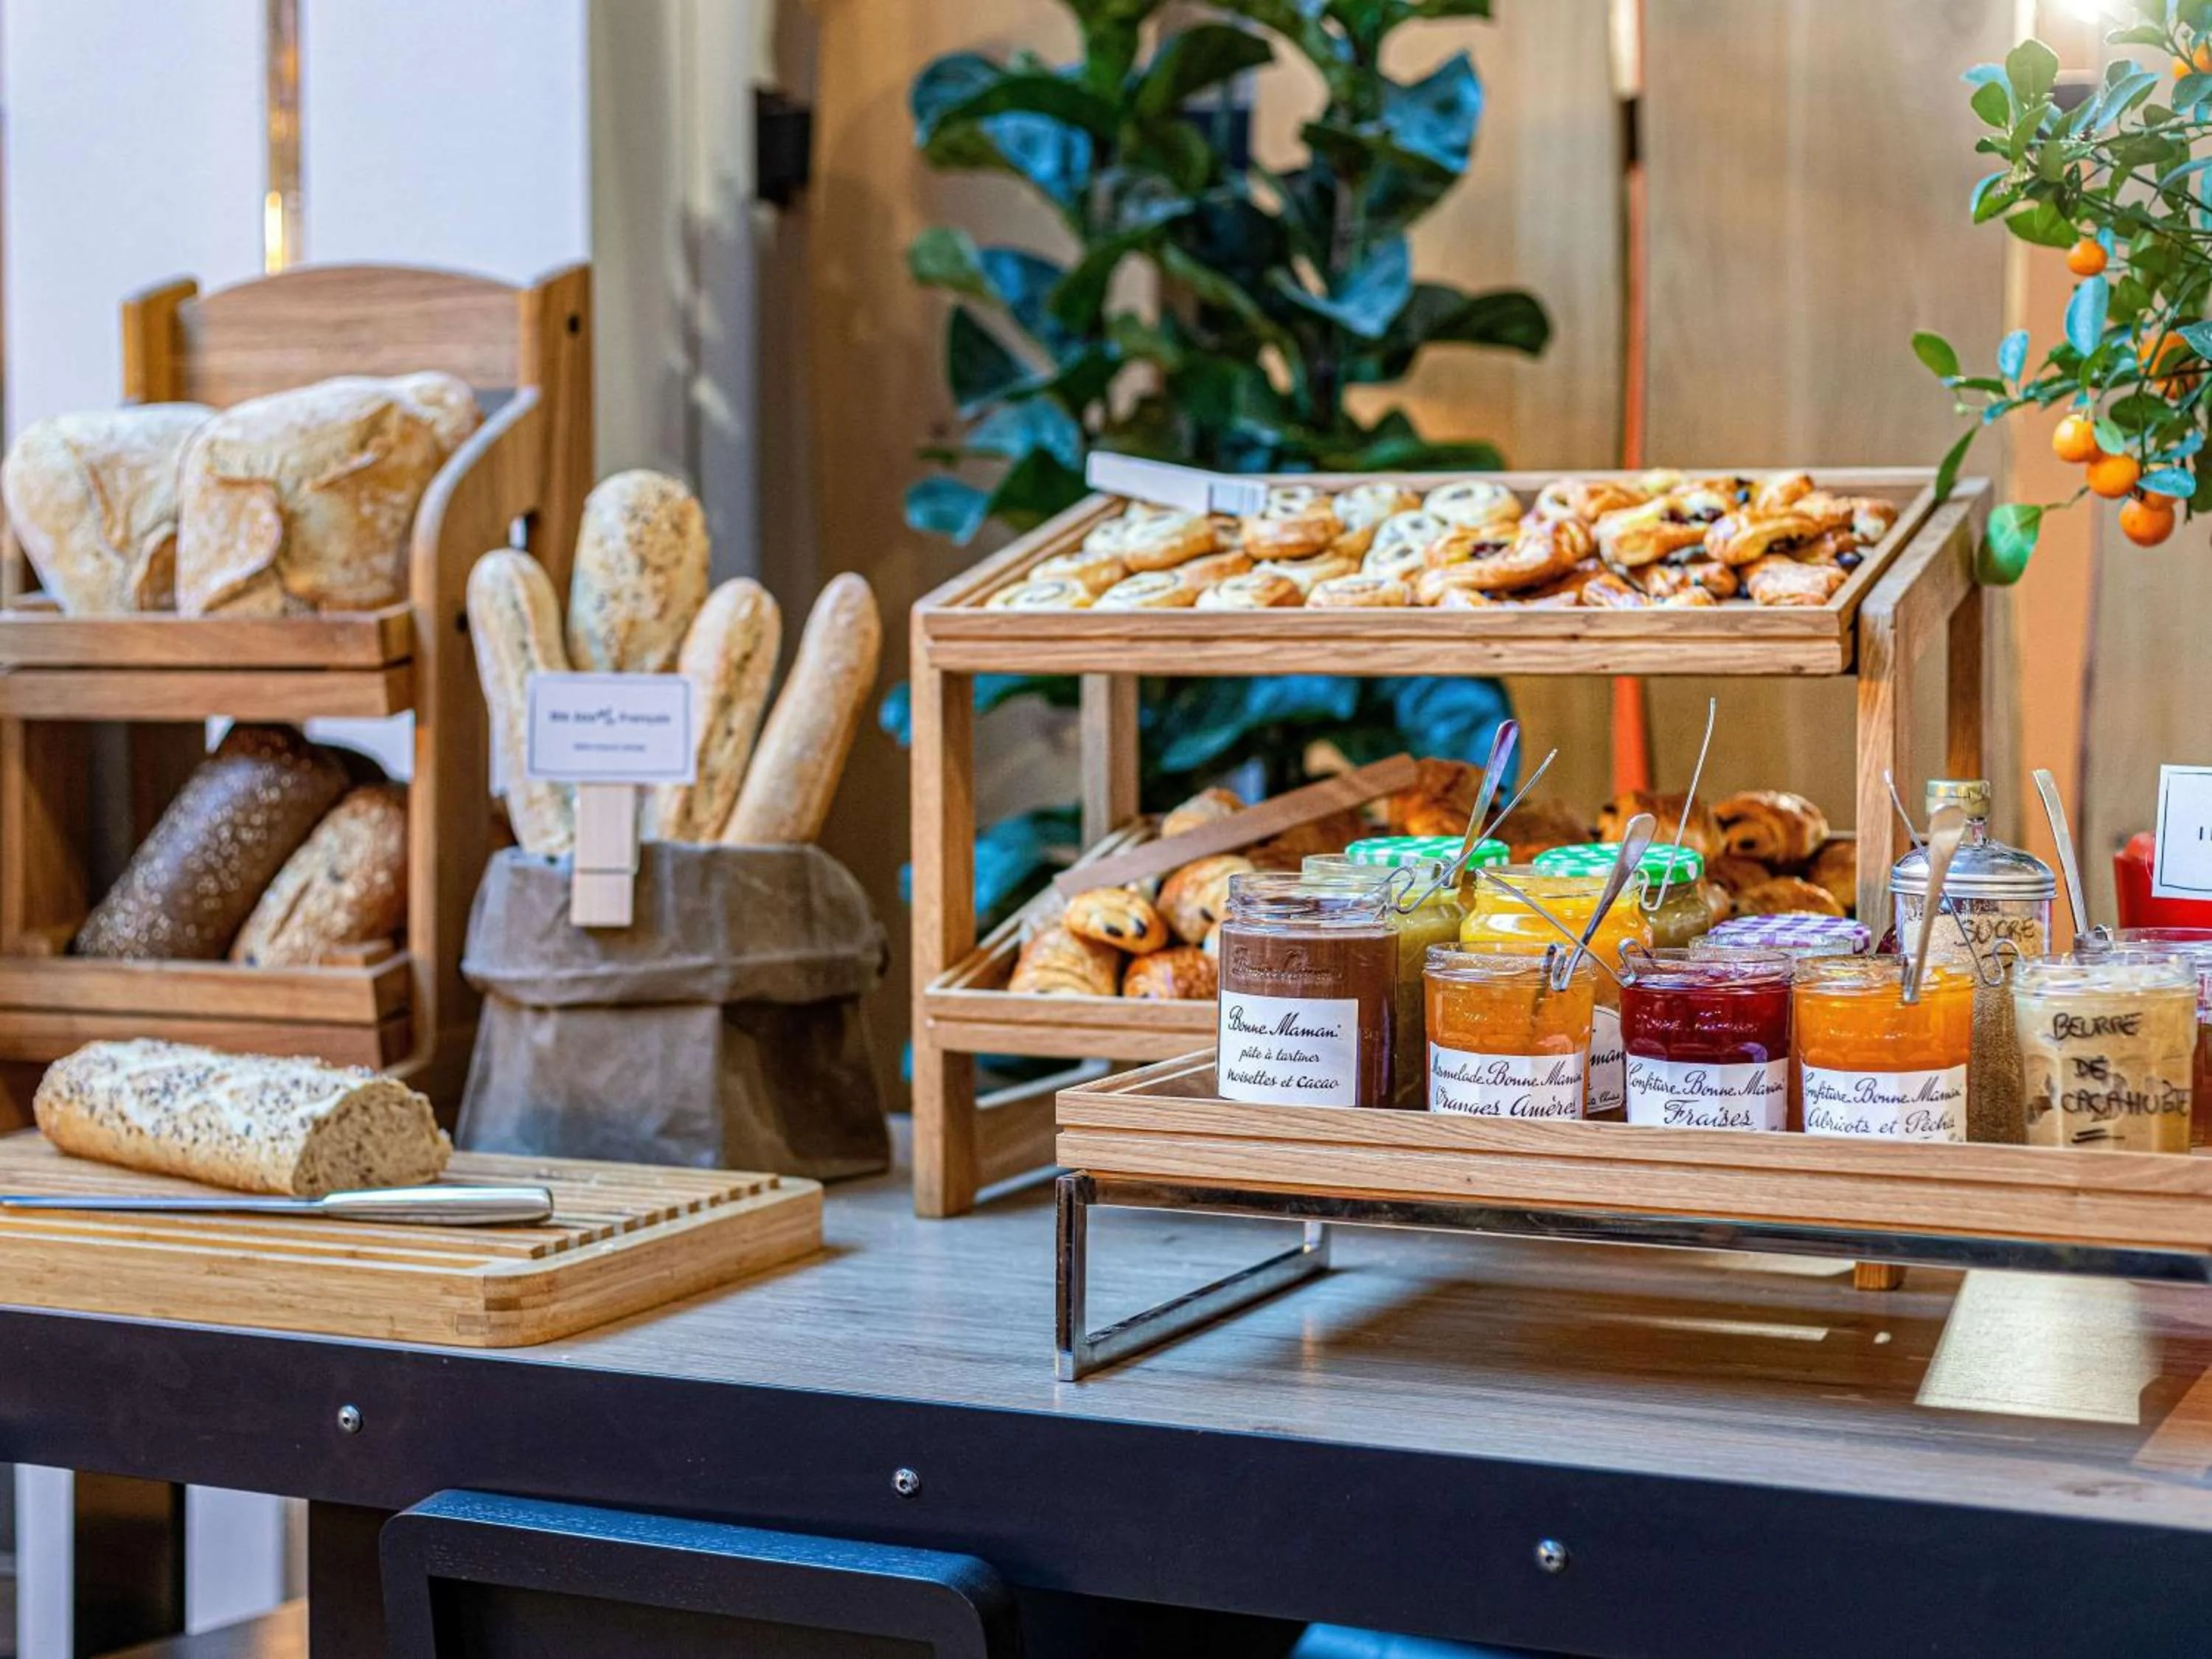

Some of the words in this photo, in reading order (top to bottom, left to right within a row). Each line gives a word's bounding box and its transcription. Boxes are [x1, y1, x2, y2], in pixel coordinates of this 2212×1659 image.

[1954, 917, 2034, 947] SUCRE
[1228, 1005, 1267, 1034] Bonne
[1269, 1012, 1338, 1037] Maman
[2051, 1012, 2143, 1040] BEURRE
[1239, 1046, 1262, 1062] pâte
[1265, 1048, 1273, 1060] à
[1276, 1048, 1321, 1062] tartiner
[1281, 1076, 1293, 1088] et
[1296, 1075, 1340, 1089] Cacao
[1486, 1060, 1540, 1087] Bonne
[1682, 1069, 1737, 1096] Bonne
[1853, 1077, 1910, 1104] Bonne
[1664, 1099, 1754, 1127] Fraises
[1809, 1108, 1871, 1133] Abricots
[1879, 1120, 1899, 1134] et
